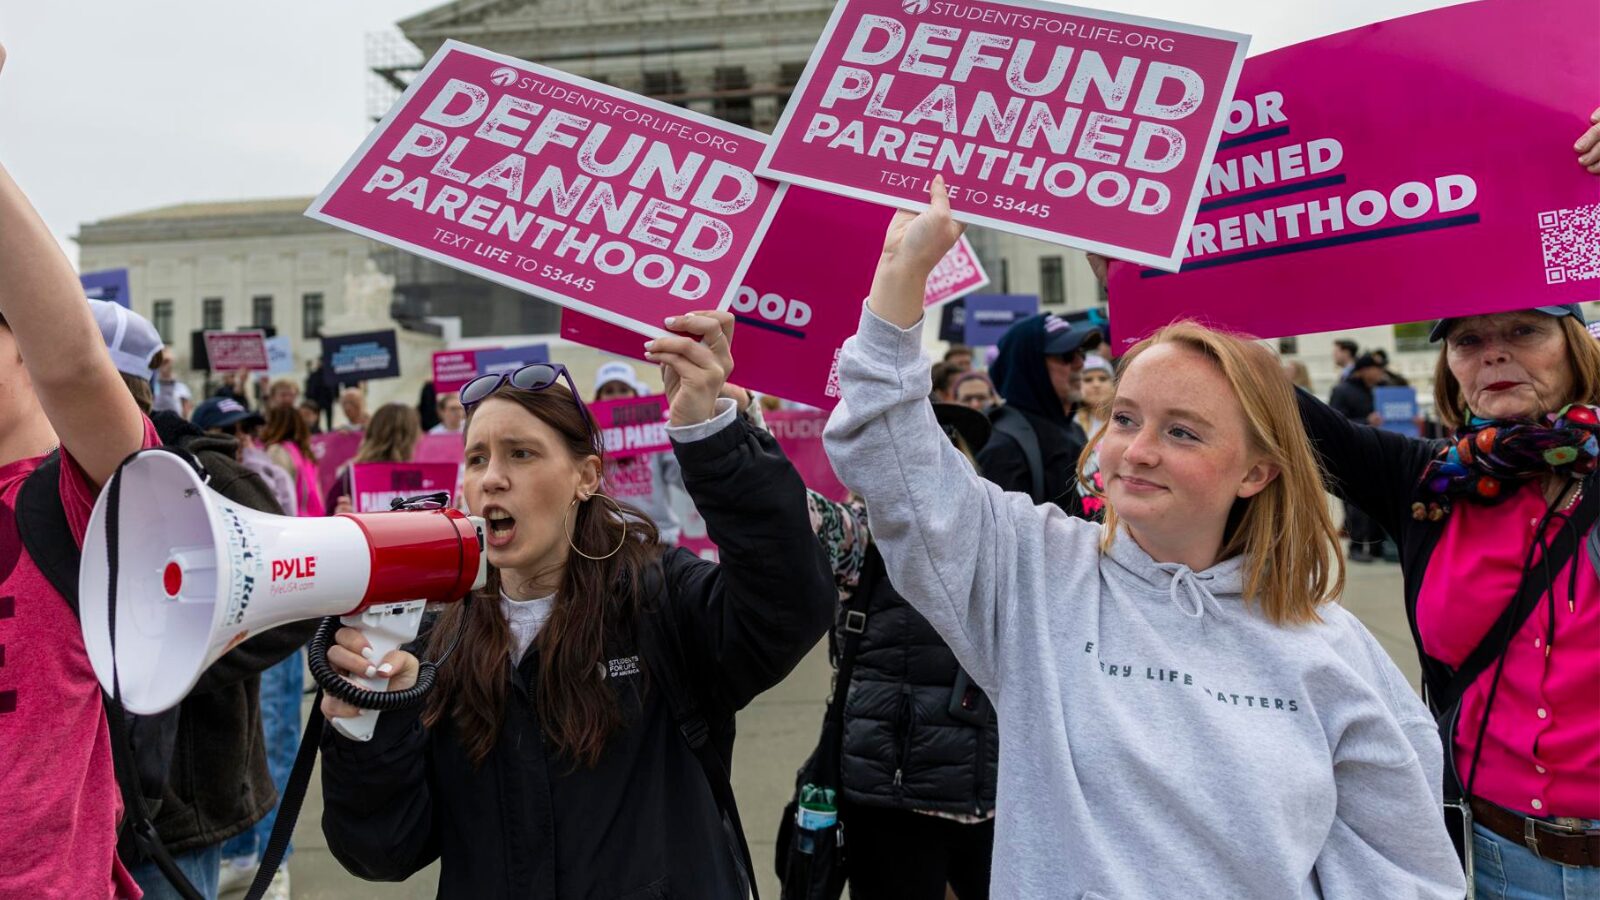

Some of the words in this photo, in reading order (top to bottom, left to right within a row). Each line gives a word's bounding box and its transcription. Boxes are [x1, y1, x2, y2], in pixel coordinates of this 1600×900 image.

[931, 1, 1175, 53] STUDENTSFORLIFE.ORG
[841, 13, 1205, 121] DEFUND
[517, 76, 739, 154] STUDENTSFORLIFE.ORG
[819, 65, 1187, 174] PLANNED
[1223, 91, 1288, 134] OR
[420, 78, 758, 215] DEFUND
[802, 113, 1171, 216] PARENTHOOD
[1201, 138, 1344, 198] NNED
[388, 122, 734, 263] PLANNED
[880, 170, 920, 190] TEXT
[922, 180, 960, 199] LE
[964, 187, 989, 206] TO
[992, 195, 1050, 219] 53445
[1183, 174, 1478, 259] RENTHOOD
[362, 165, 711, 301] PARENTHOOD
[433, 227, 474, 251] TEXT
[474, 240, 513, 265] LIFE
[515, 254, 538, 273] TO
[540, 263, 596, 293] 53445
[732, 285, 812, 327] OOD
[272, 556, 316, 581] PYLE
[609, 664, 623, 672] FOR
[1147, 667, 1193, 686] LIFE
[1203, 686, 1299, 712] ATTERS
